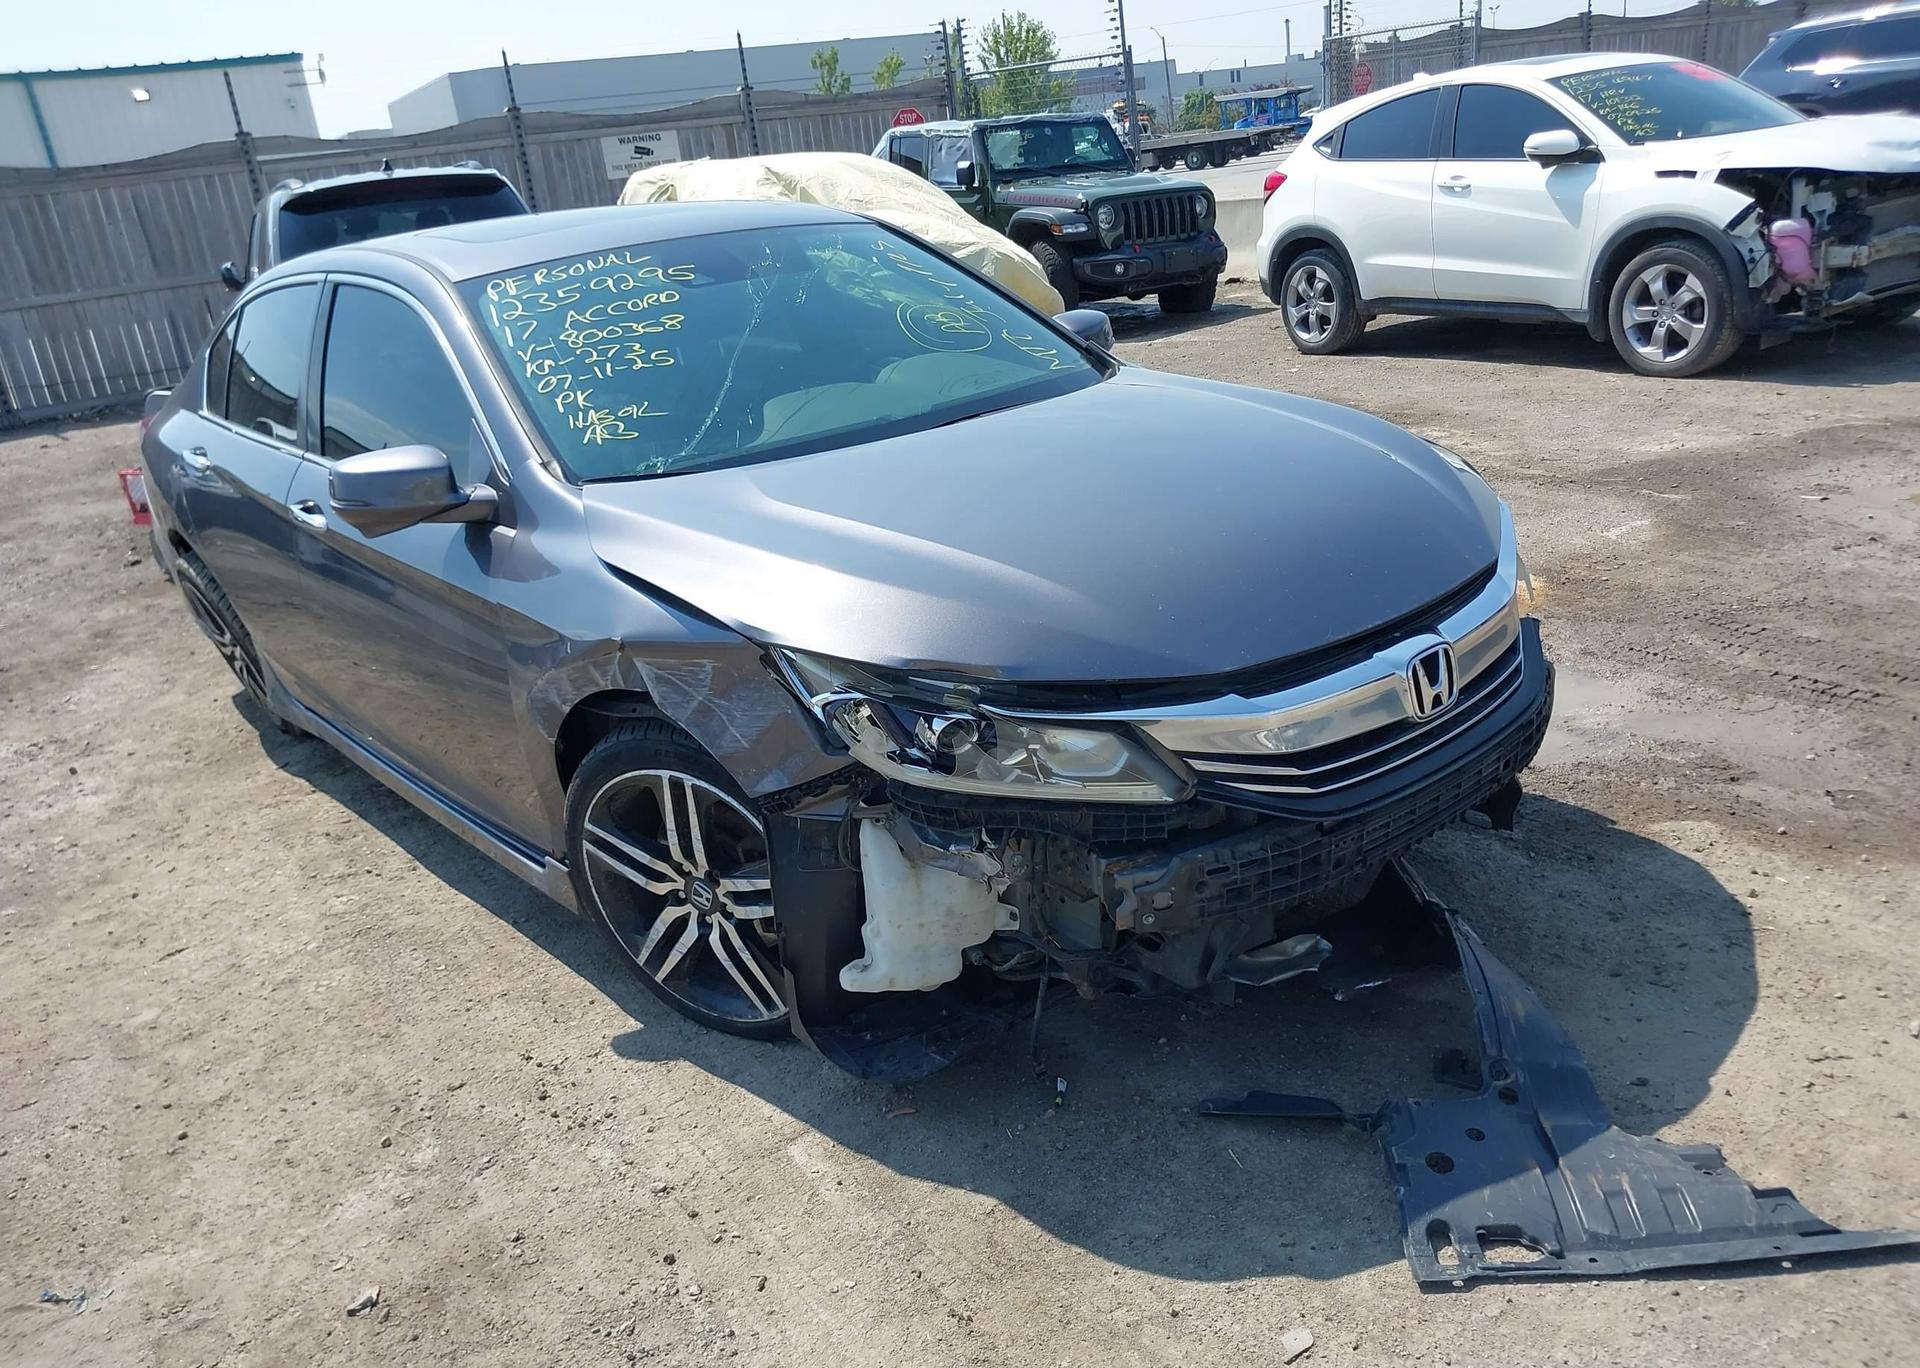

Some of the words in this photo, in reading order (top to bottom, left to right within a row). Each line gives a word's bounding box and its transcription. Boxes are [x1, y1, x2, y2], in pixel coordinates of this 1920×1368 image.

[899, 112, 917, 124] STOP
[617, 133, 662, 145] WARNING
[487, 252, 652, 301] PERSONAL
[505, 320, 538, 347] 17
[565, 290, 680, 329] ACCORD
[555, 389, 594, 413] PK
